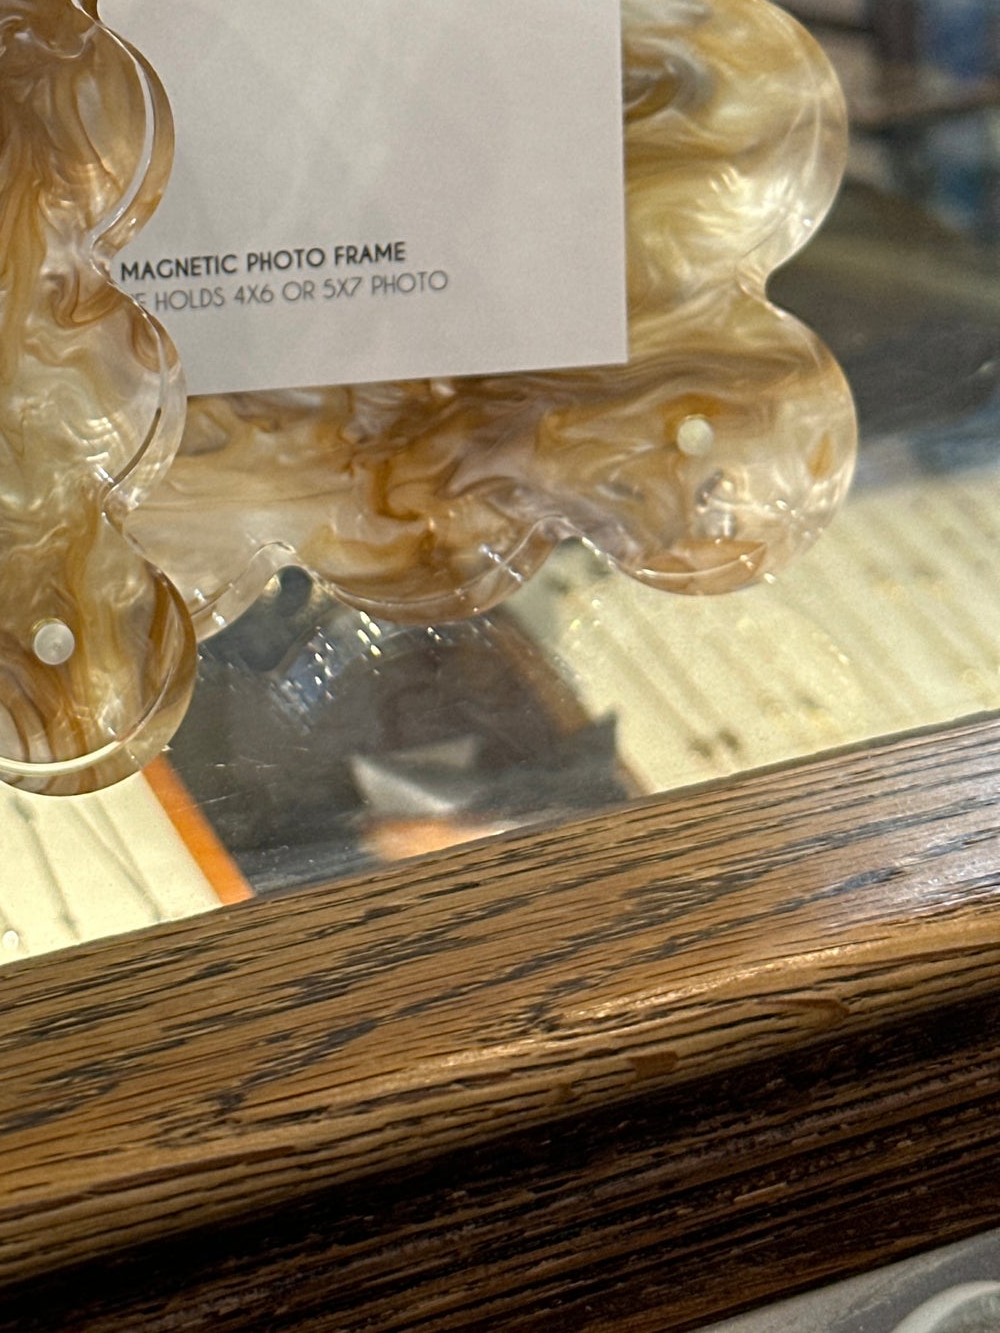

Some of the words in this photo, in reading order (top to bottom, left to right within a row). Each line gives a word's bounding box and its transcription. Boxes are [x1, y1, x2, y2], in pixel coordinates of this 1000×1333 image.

[121, 254, 237, 281] MAGNETIC
[246, 248, 325, 272] PHOTO
[334, 241, 406, 266] FRAME
[155, 287, 226, 312] HOLDS
[234, 283, 274, 305] 4X6
[281, 280, 315, 303] OR
[323, 276, 363, 300] 5X7
[371, 269, 449, 295] PHOTO
